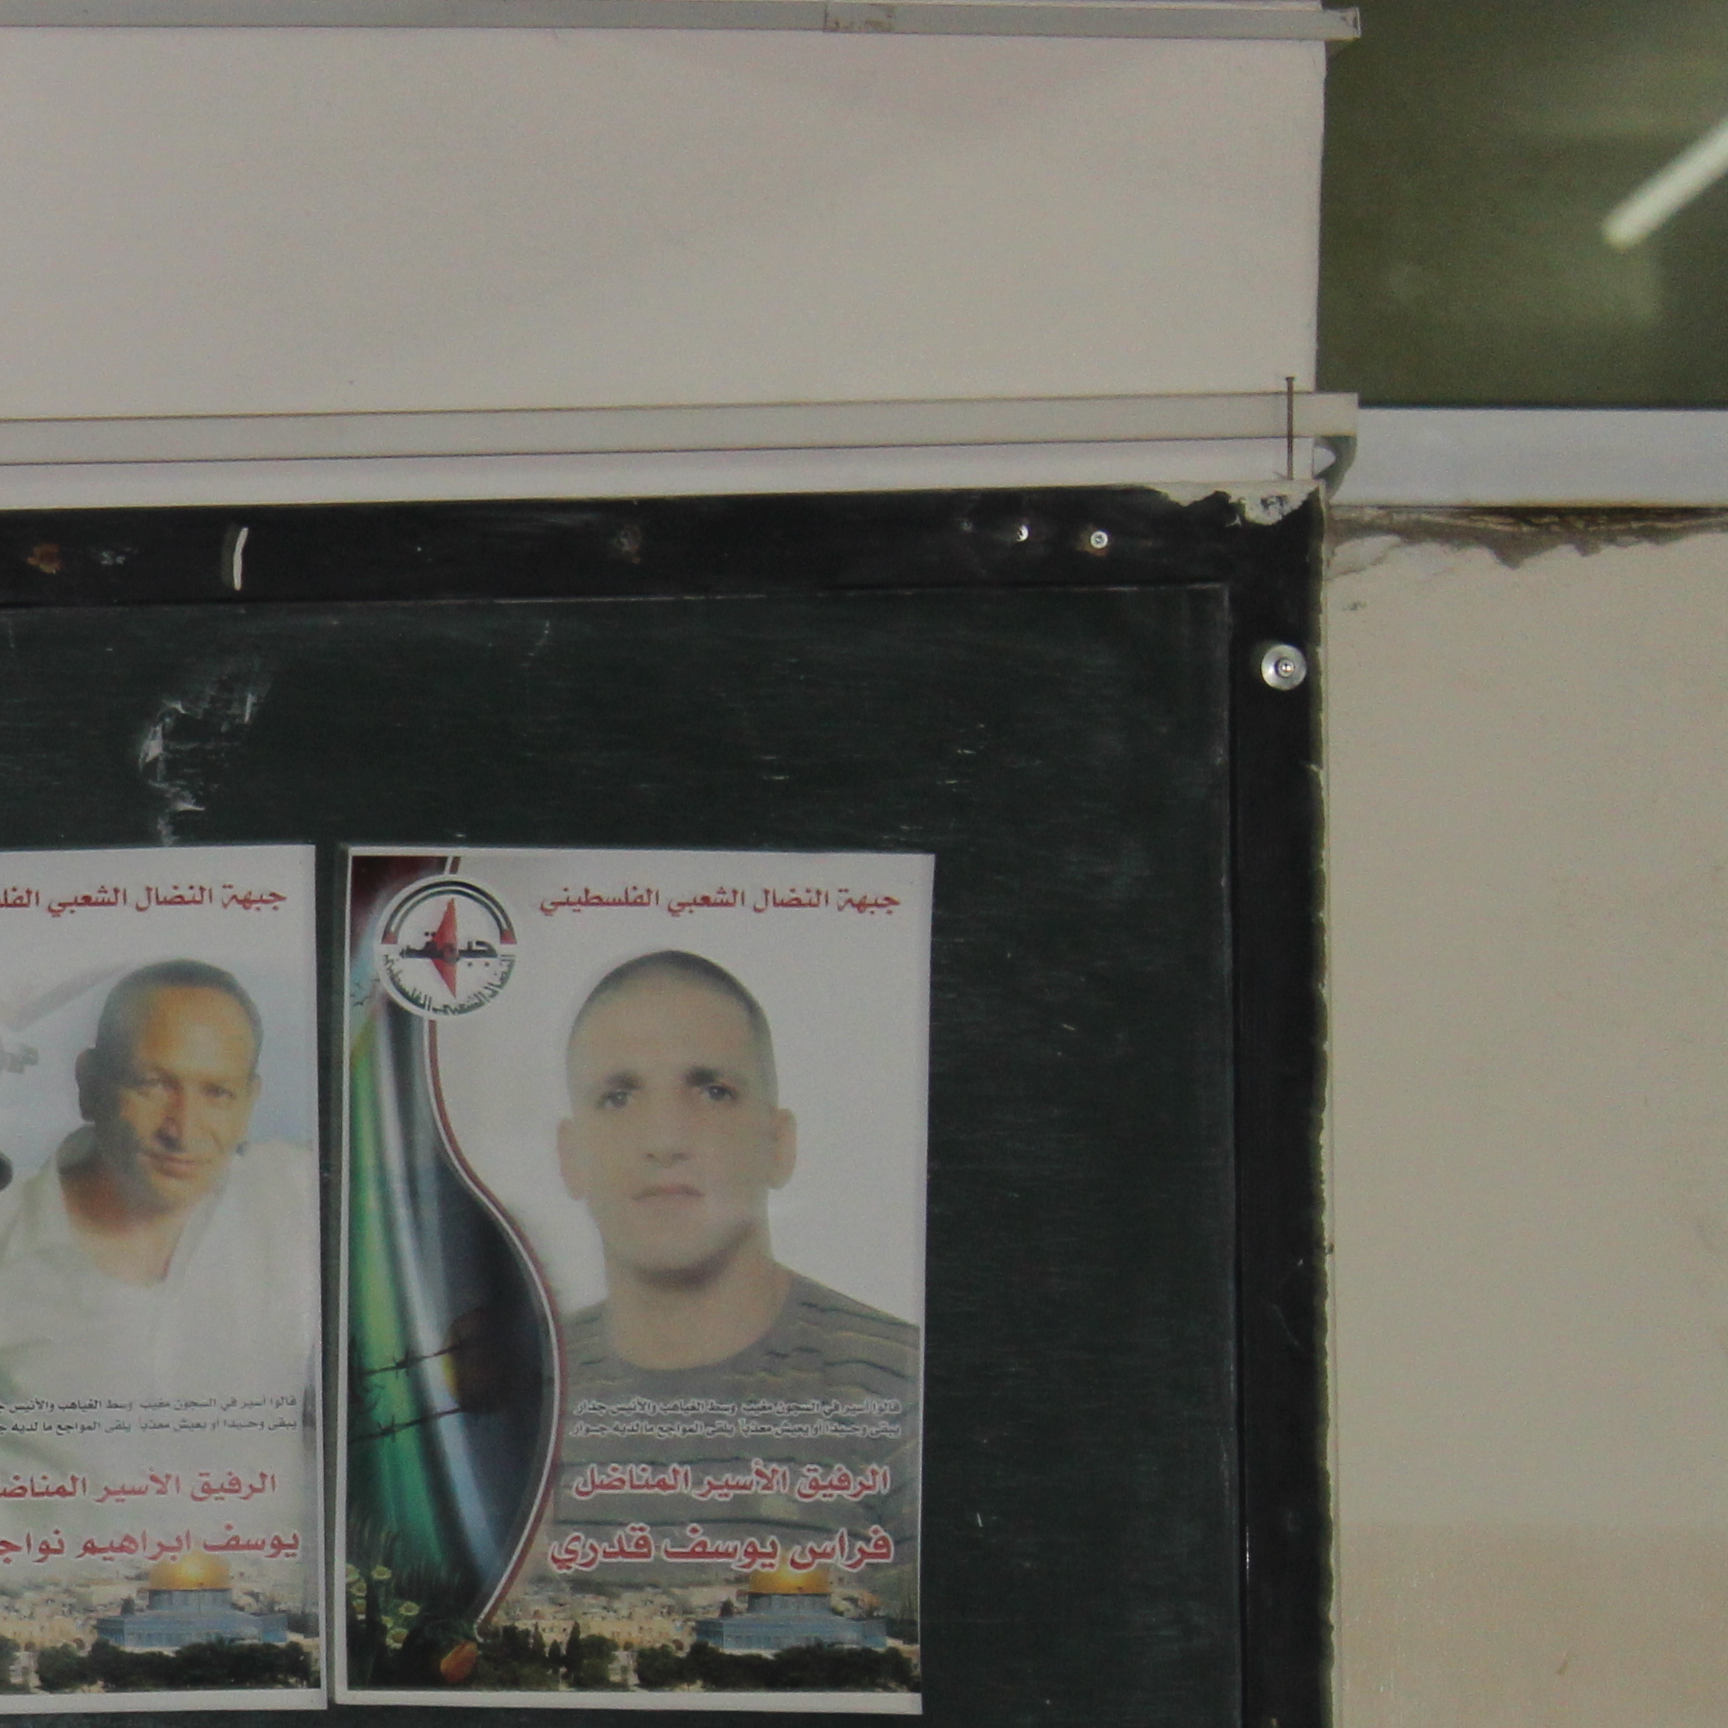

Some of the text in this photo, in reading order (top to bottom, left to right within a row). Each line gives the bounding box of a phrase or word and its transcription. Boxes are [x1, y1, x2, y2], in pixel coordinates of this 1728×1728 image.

[47, 885, 127, 918] الشعبي
[135, 885, 214, 913] النضال
[221, 884, 287, 912] جبهة
[539, 886, 901, 918] جبهة النضال الشعبي الفلسطيني
[92, 1467, 181, 1504] الأسير
[189, 1469, 276, 1503] الرفيق
[573, 1458, 891, 1501] الرفيق الأسير المناضل
[75, 1529, 191, 1563] ابراهيم
[202, 1523, 301, 1560] يوسف
[548, 1522, 895, 1572] فراس يوسف قدري
